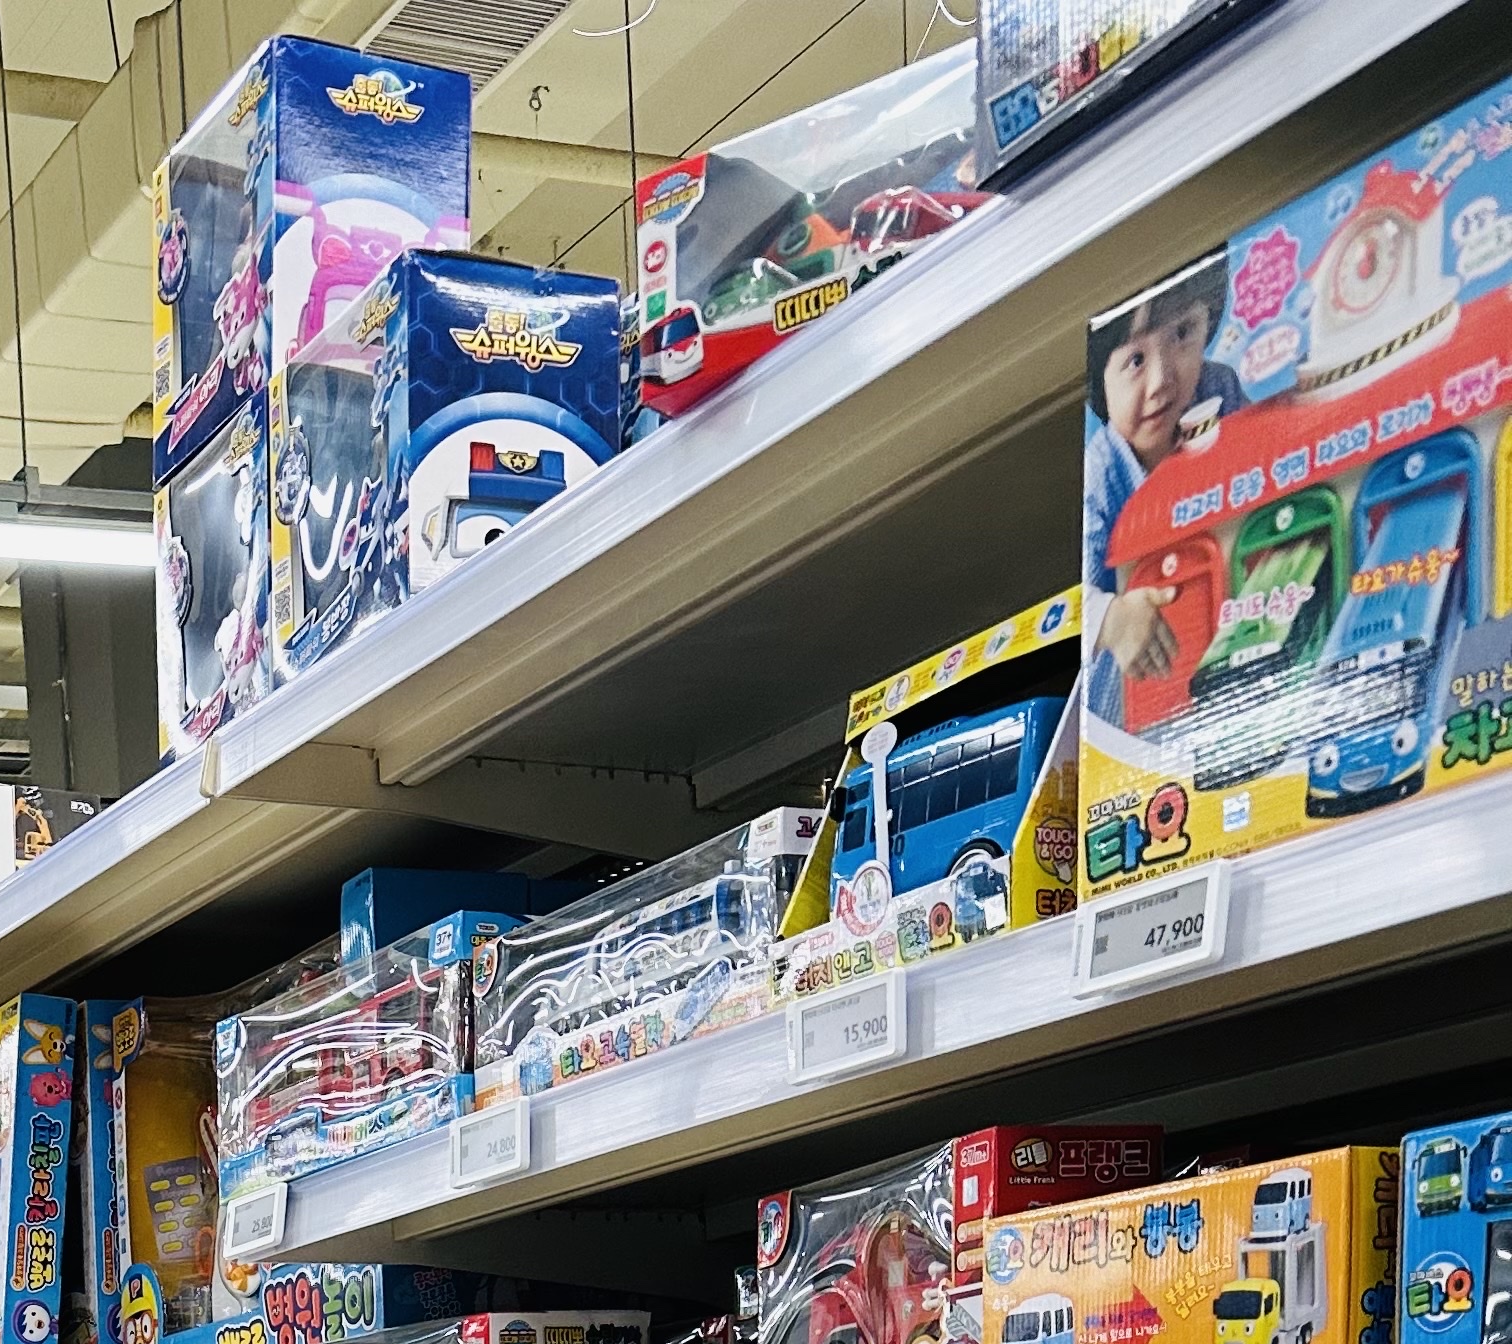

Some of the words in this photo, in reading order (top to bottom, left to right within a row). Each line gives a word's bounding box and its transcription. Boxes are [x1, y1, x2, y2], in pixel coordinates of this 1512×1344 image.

[456, 328, 582, 370] 슈퍼윙스
[1037, 827, 1076, 847] TOUCH
[1086, 782, 1191, 882] 타요
[1144, 913, 1204, 947] 47,900
[843, 1016, 888, 1044] 15,900
[1013, 1141, 1051, 1169] 리틀
[1059, 1139, 1151, 1184] 프랭크
[27, 1227, 57, 1291] 뽀로로
[1407, 1268, 1473, 1317] 타요
